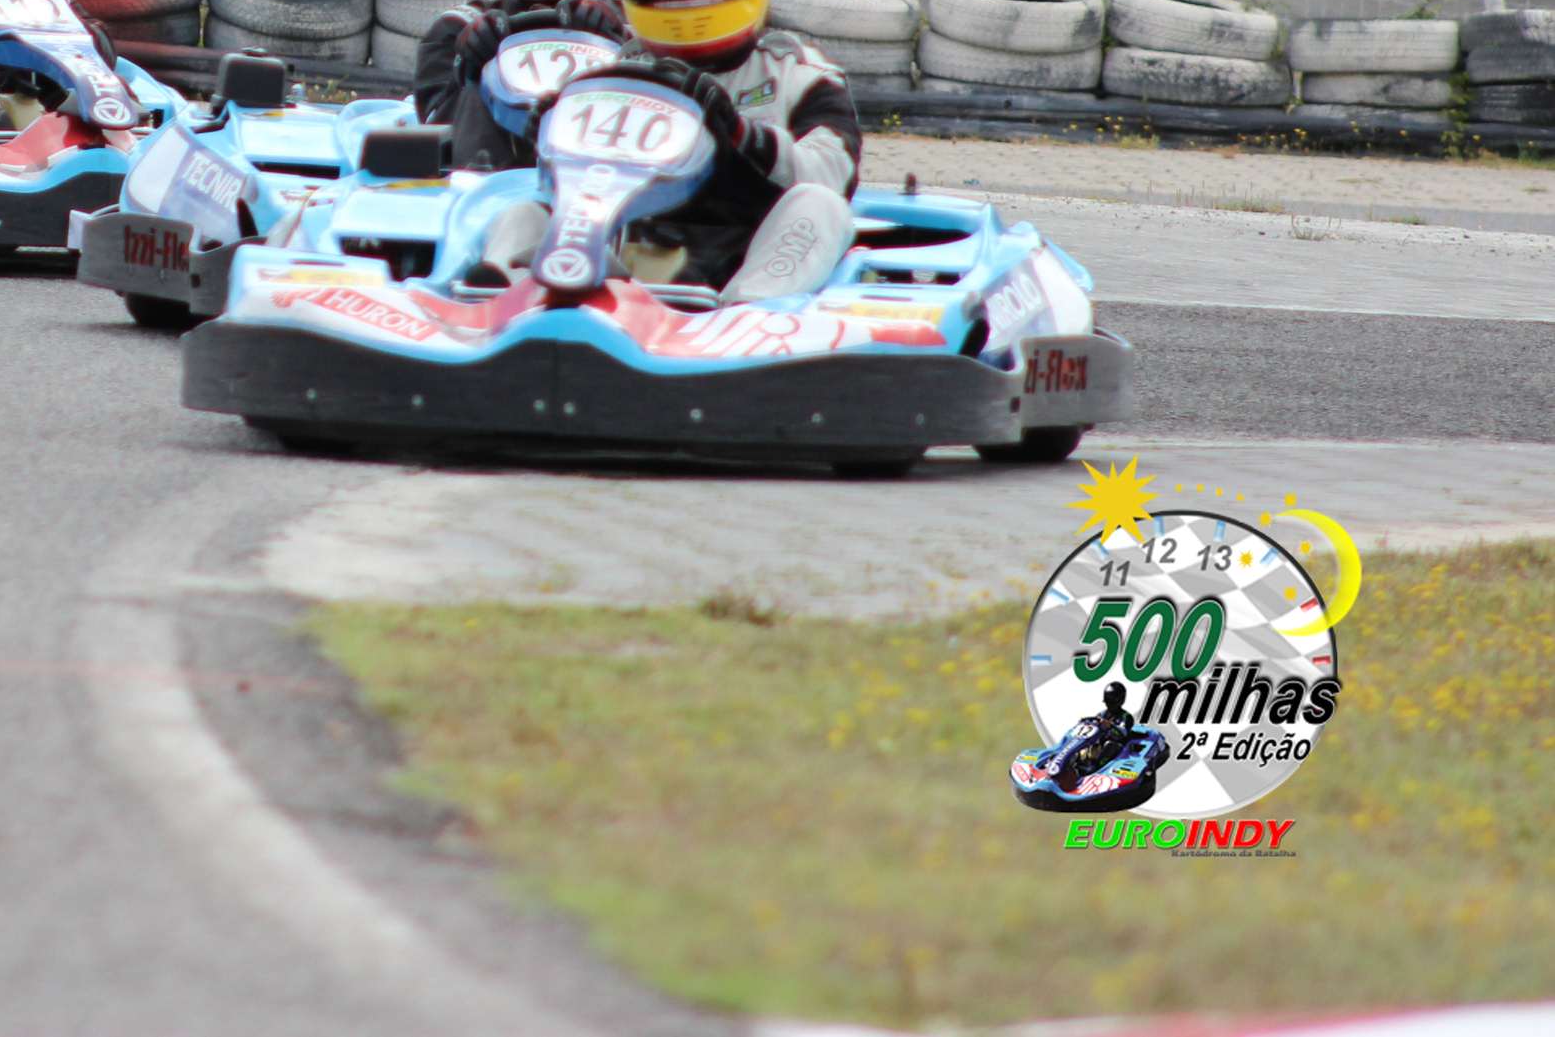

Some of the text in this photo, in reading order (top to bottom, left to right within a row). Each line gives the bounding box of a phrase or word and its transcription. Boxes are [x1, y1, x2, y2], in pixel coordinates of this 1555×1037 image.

[571, 101, 673, 153] 140
[765, 217, 817, 277] OMP
[325, 290, 427, 338] HURON
